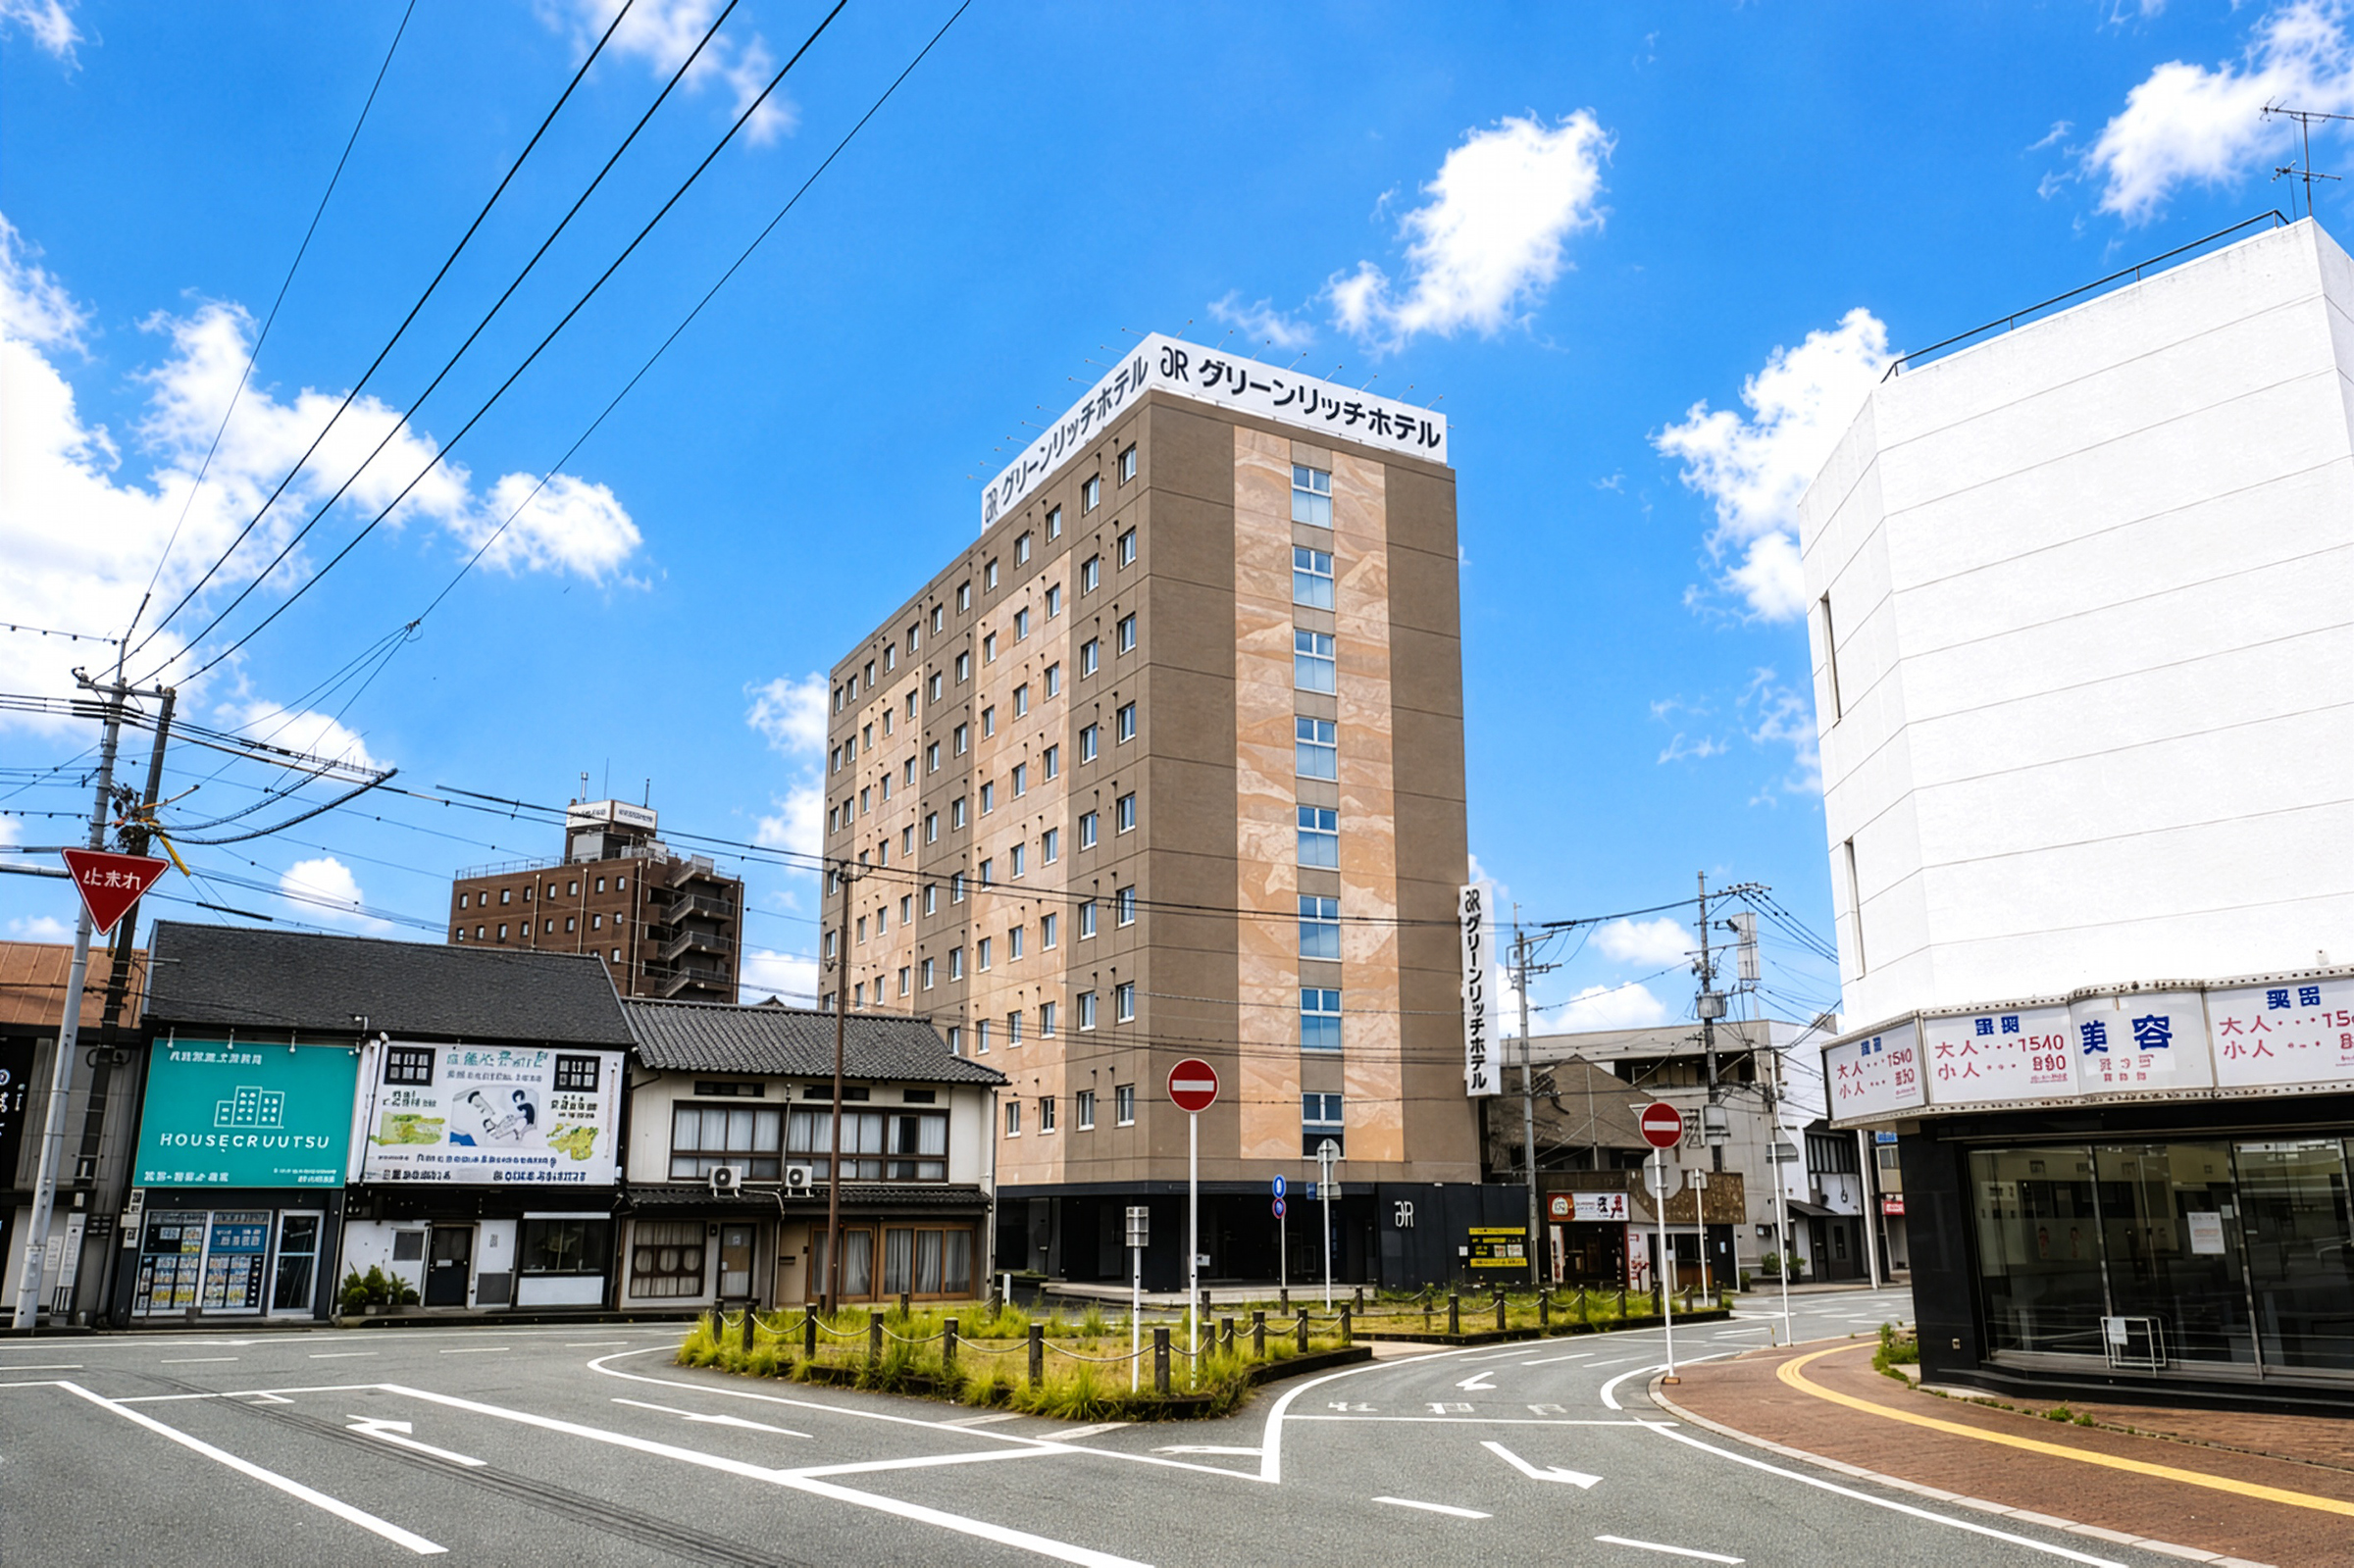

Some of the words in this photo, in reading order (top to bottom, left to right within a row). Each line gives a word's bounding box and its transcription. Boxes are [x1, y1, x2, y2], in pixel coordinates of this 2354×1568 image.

[1198, 358, 1442, 449] グリーンリッチホテル
[1000, 355, 1149, 506] グリーンリッチホテル
[1464, 913, 1488, 1090] グリーンリッチホテル
[2079, 1014, 2173, 1055] 美容
[2219, 1014, 2273, 1037] 大人
[1935, 1039, 1978, 1059] 大人
[2224, 1038, 2275, 1059] 小人
[1938, 1061, 1980, 1081] 小人
